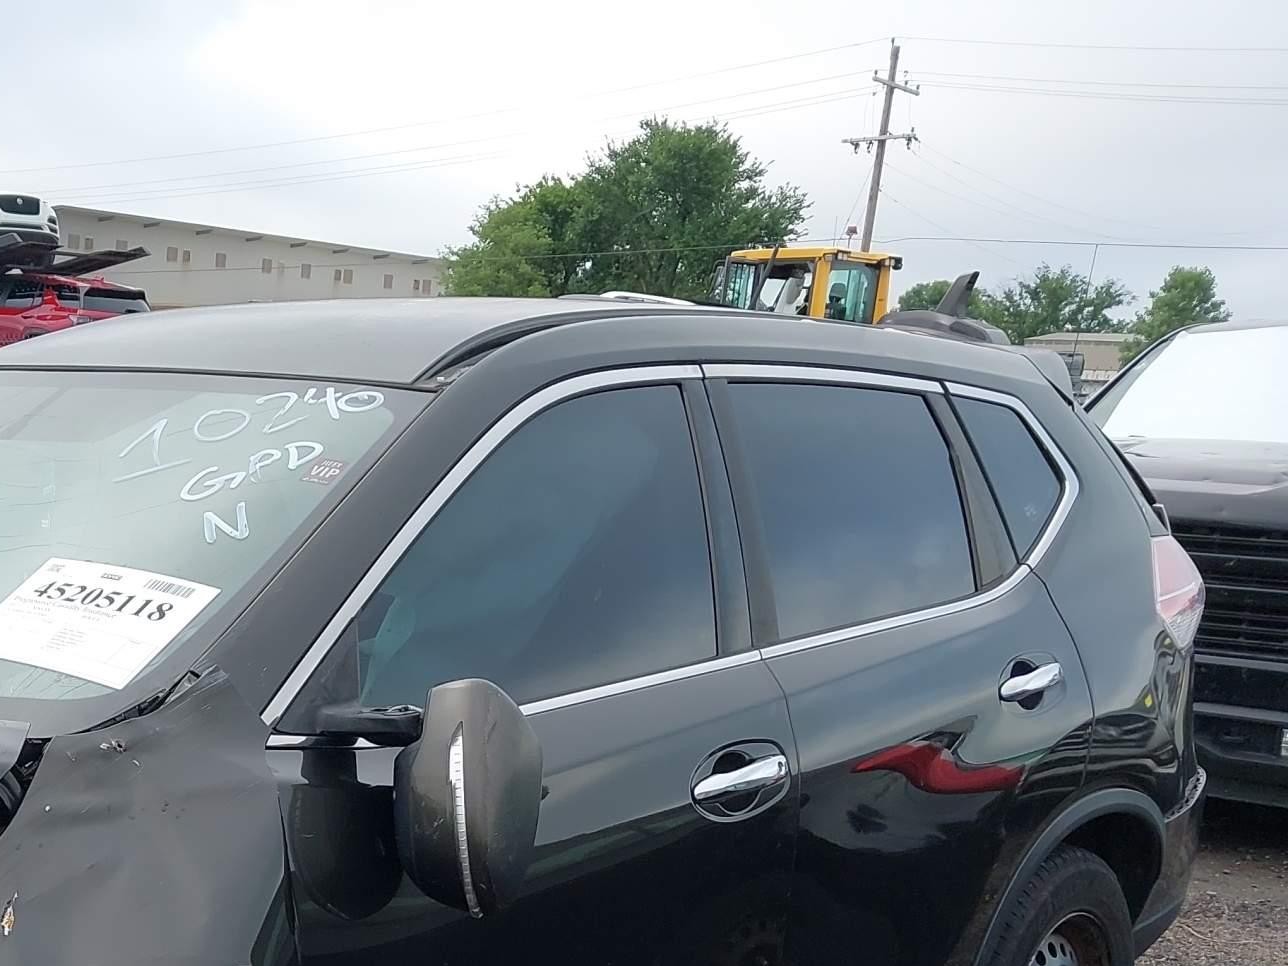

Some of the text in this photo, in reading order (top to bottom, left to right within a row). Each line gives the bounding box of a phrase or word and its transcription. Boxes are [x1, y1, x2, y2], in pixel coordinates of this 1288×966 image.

[310, 464, 341, 479] VIP
[203, 501, 251, 544] N
[33, 580, 175, 622] 45205118
